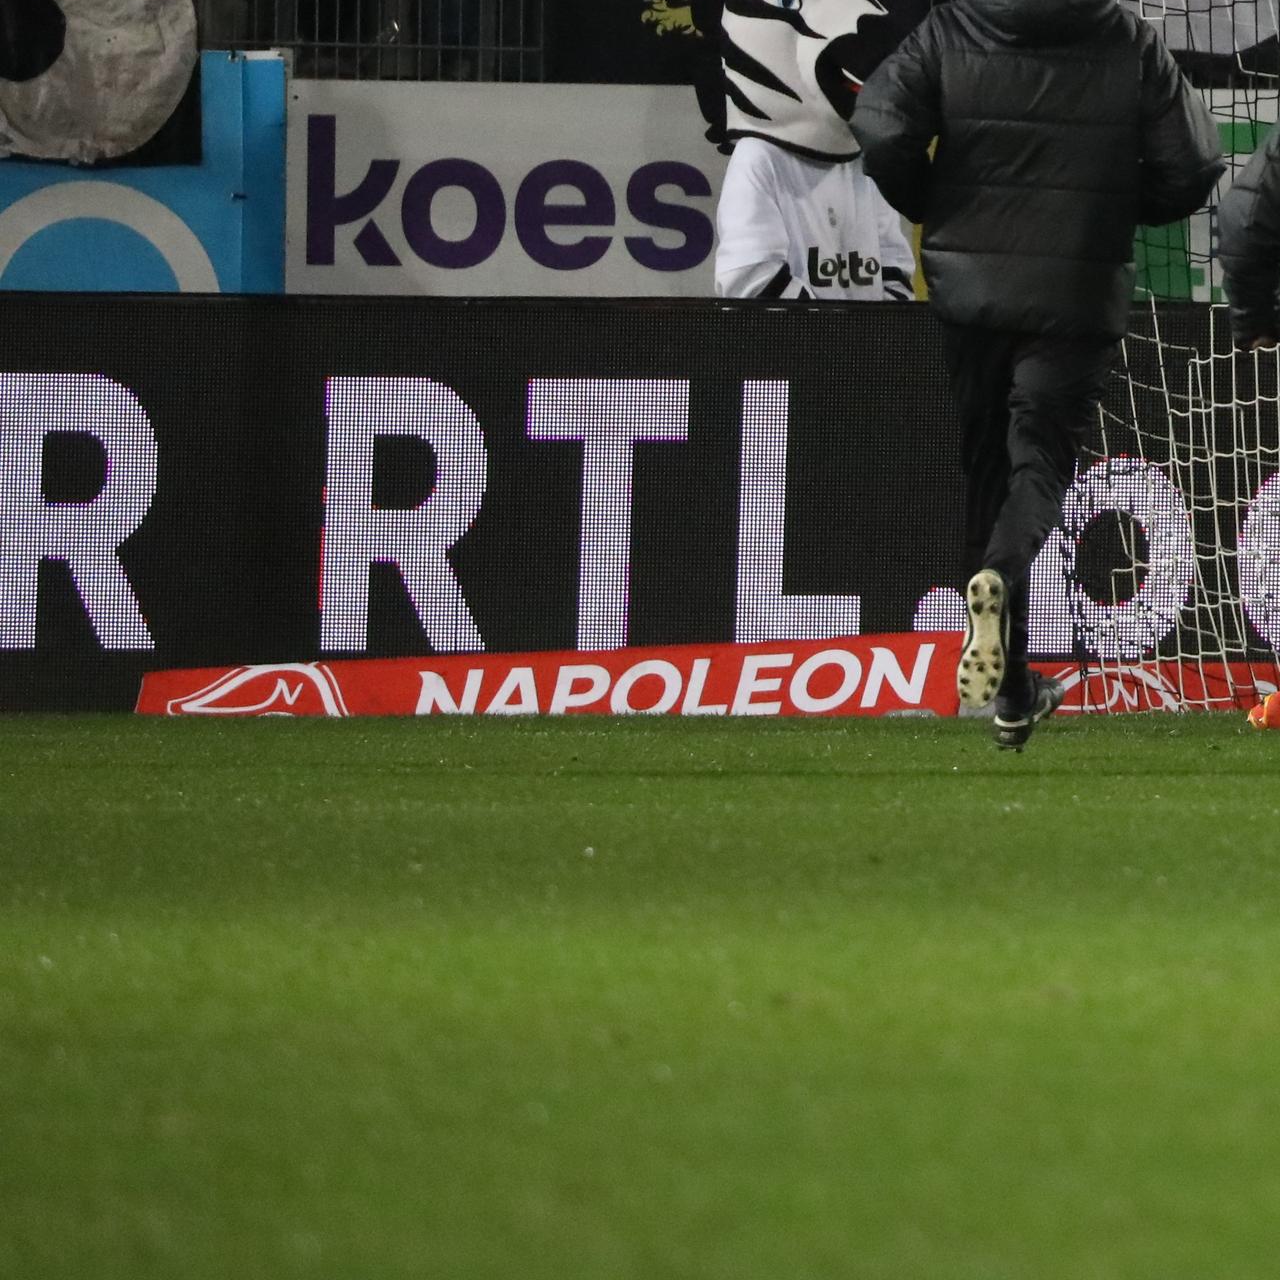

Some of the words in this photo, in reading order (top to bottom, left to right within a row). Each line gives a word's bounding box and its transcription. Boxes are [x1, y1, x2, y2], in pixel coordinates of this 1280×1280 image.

[306, 115, 714, 273] koes
[807, 246, 880, 288] Lotto
[414, 642, 936, 718] NAPOLEON
